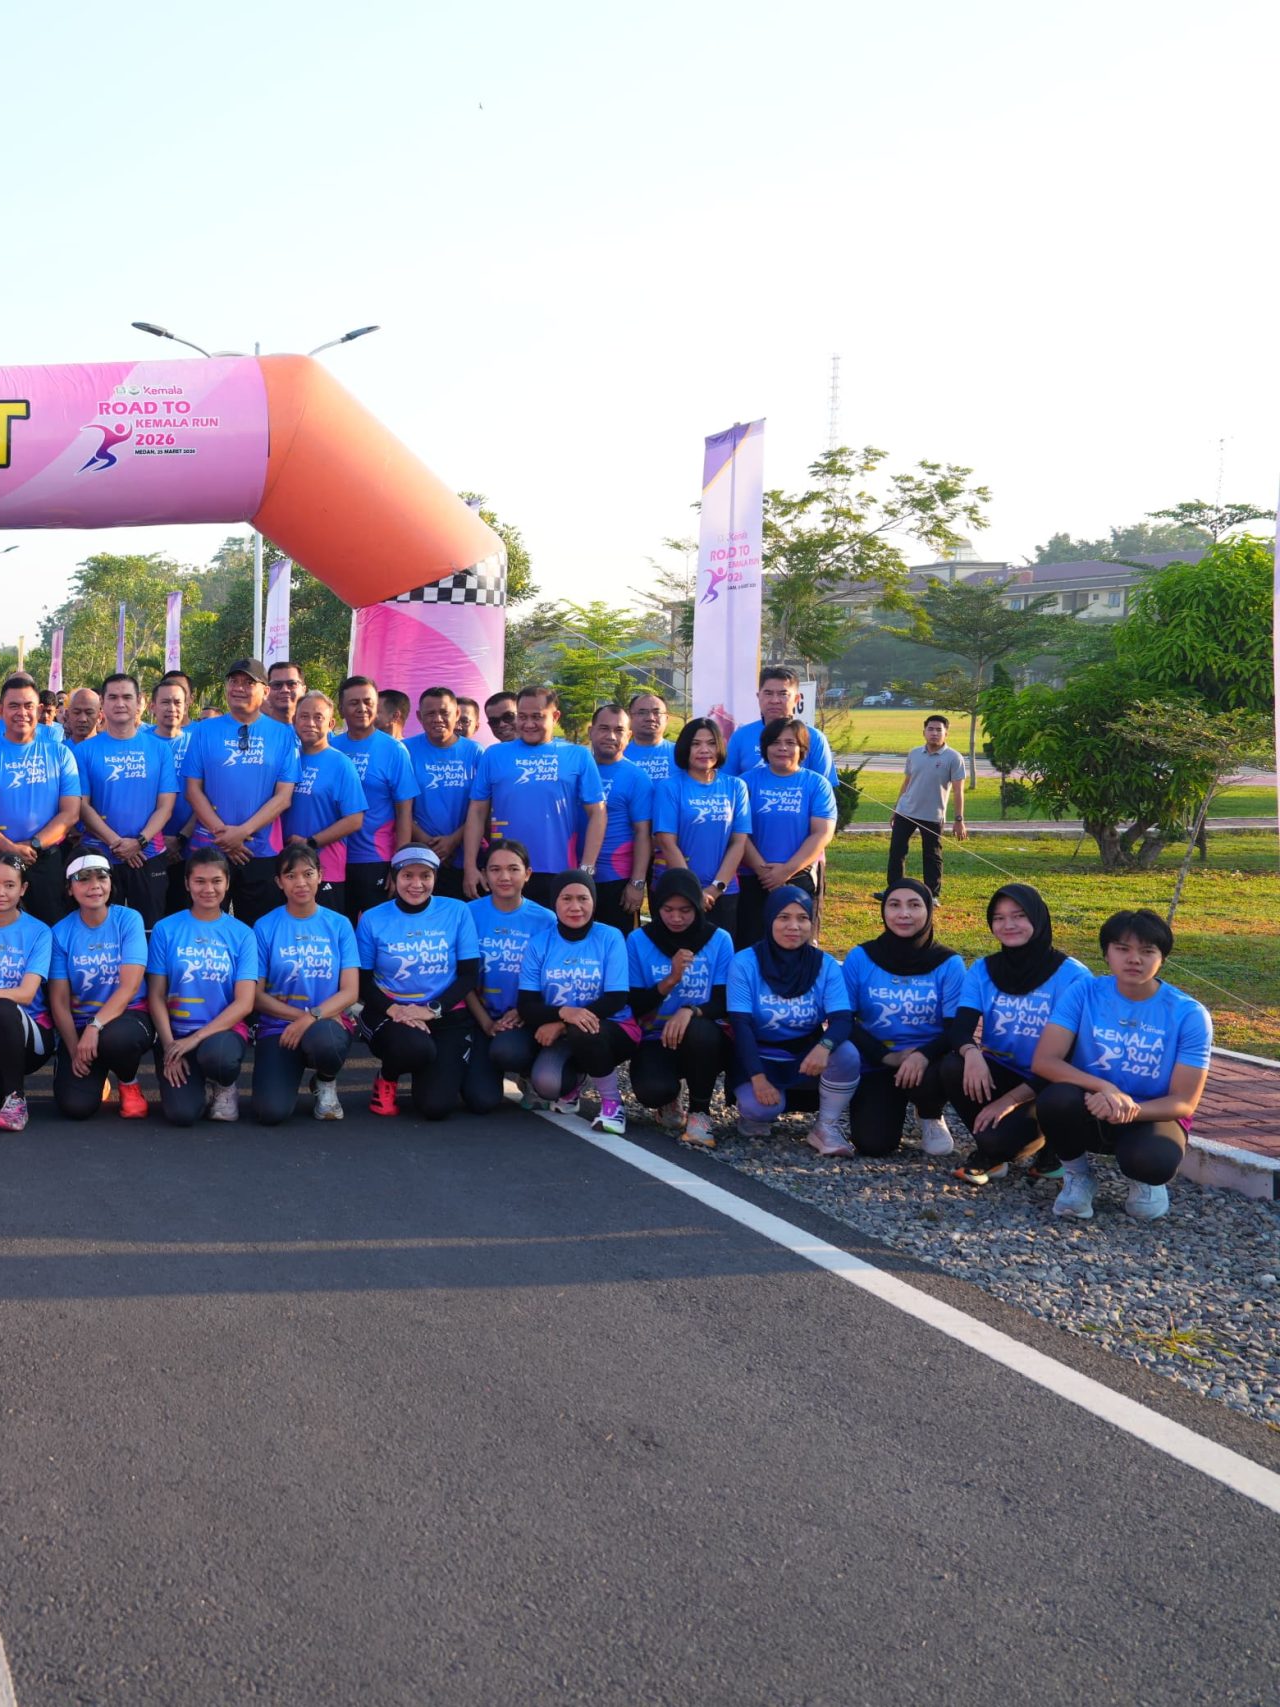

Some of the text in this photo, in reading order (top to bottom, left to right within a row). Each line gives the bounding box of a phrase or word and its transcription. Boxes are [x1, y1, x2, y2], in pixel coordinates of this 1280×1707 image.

[143, 385, 183, 395] Kemala
[99, 401, 191, 415] ROAD TO
[135, 417, 218, 428] KEMALA RUN
[135, 433, 175, 445] 2026
[739, 544, 750, 556] TO
[244, 749, 264, 757] RUN
[5, 759, 45, 770] KEMALA
[104, 755, 145, 764] KEMALA
[242, 756, 264, 765] 2026
[515, 758, 558, 767] KEMALA
[27, 767, 46, 777] RUN
[126, 762, 146, 771] RUN
[425, 764, 464, 773] KEMALA
[537, 765, 558, 774] RUN
[25, 775, 47, 785] 2026
[124, 770, 147, 779] 2026
[445, 771, 464, 780] RUN
[535, 773, 558, 782] 2026
[444, 779, 464, 787] 2026
[759, 789, 802, 798] KEMALA
[781, 797, 802, 806] RUN
[777, 805, 801, 813] 2026
[279, 943, 333, 958] KEMALA
[387, 938, 449, 953] KEMALA
[177, 946, 231, 962] KEMALA
[419, 951, 448, 964] RUN
[205, 959, 230, 973] RUN
[306, 956, 332, 968] RUN
[498, 962, 521, 973] 202
[100, 965, 121, 977] RU
[304, 967, 332, 980] 2026
[418, 963, 449, 975] 2026
[546, 967, 601, 980] KEMALA
[99, 975, 120, 985] 202
[201, 971, 227, 983] 2026
[682, 976, 709, 988] RUN
[0, 979, 19, 989] 202
[573, 979, 600, 992] RUN
[869, 987, 937, 1002] KEMALA
[792, 1005, 818, 1018] RUN
[904, 1001, 936, 1015] RUN
[900, 1015, 937, 1026] 2026
[1017, 1010, 1049, 1028] RUN
[1013, 1024, 1041, 1039] 202
[1092, 1025, 1165, 1052] KEMALA
[1126, 1044, 1163, 1065] RUN
[1121, 1060, 1162, 1080] 2026
